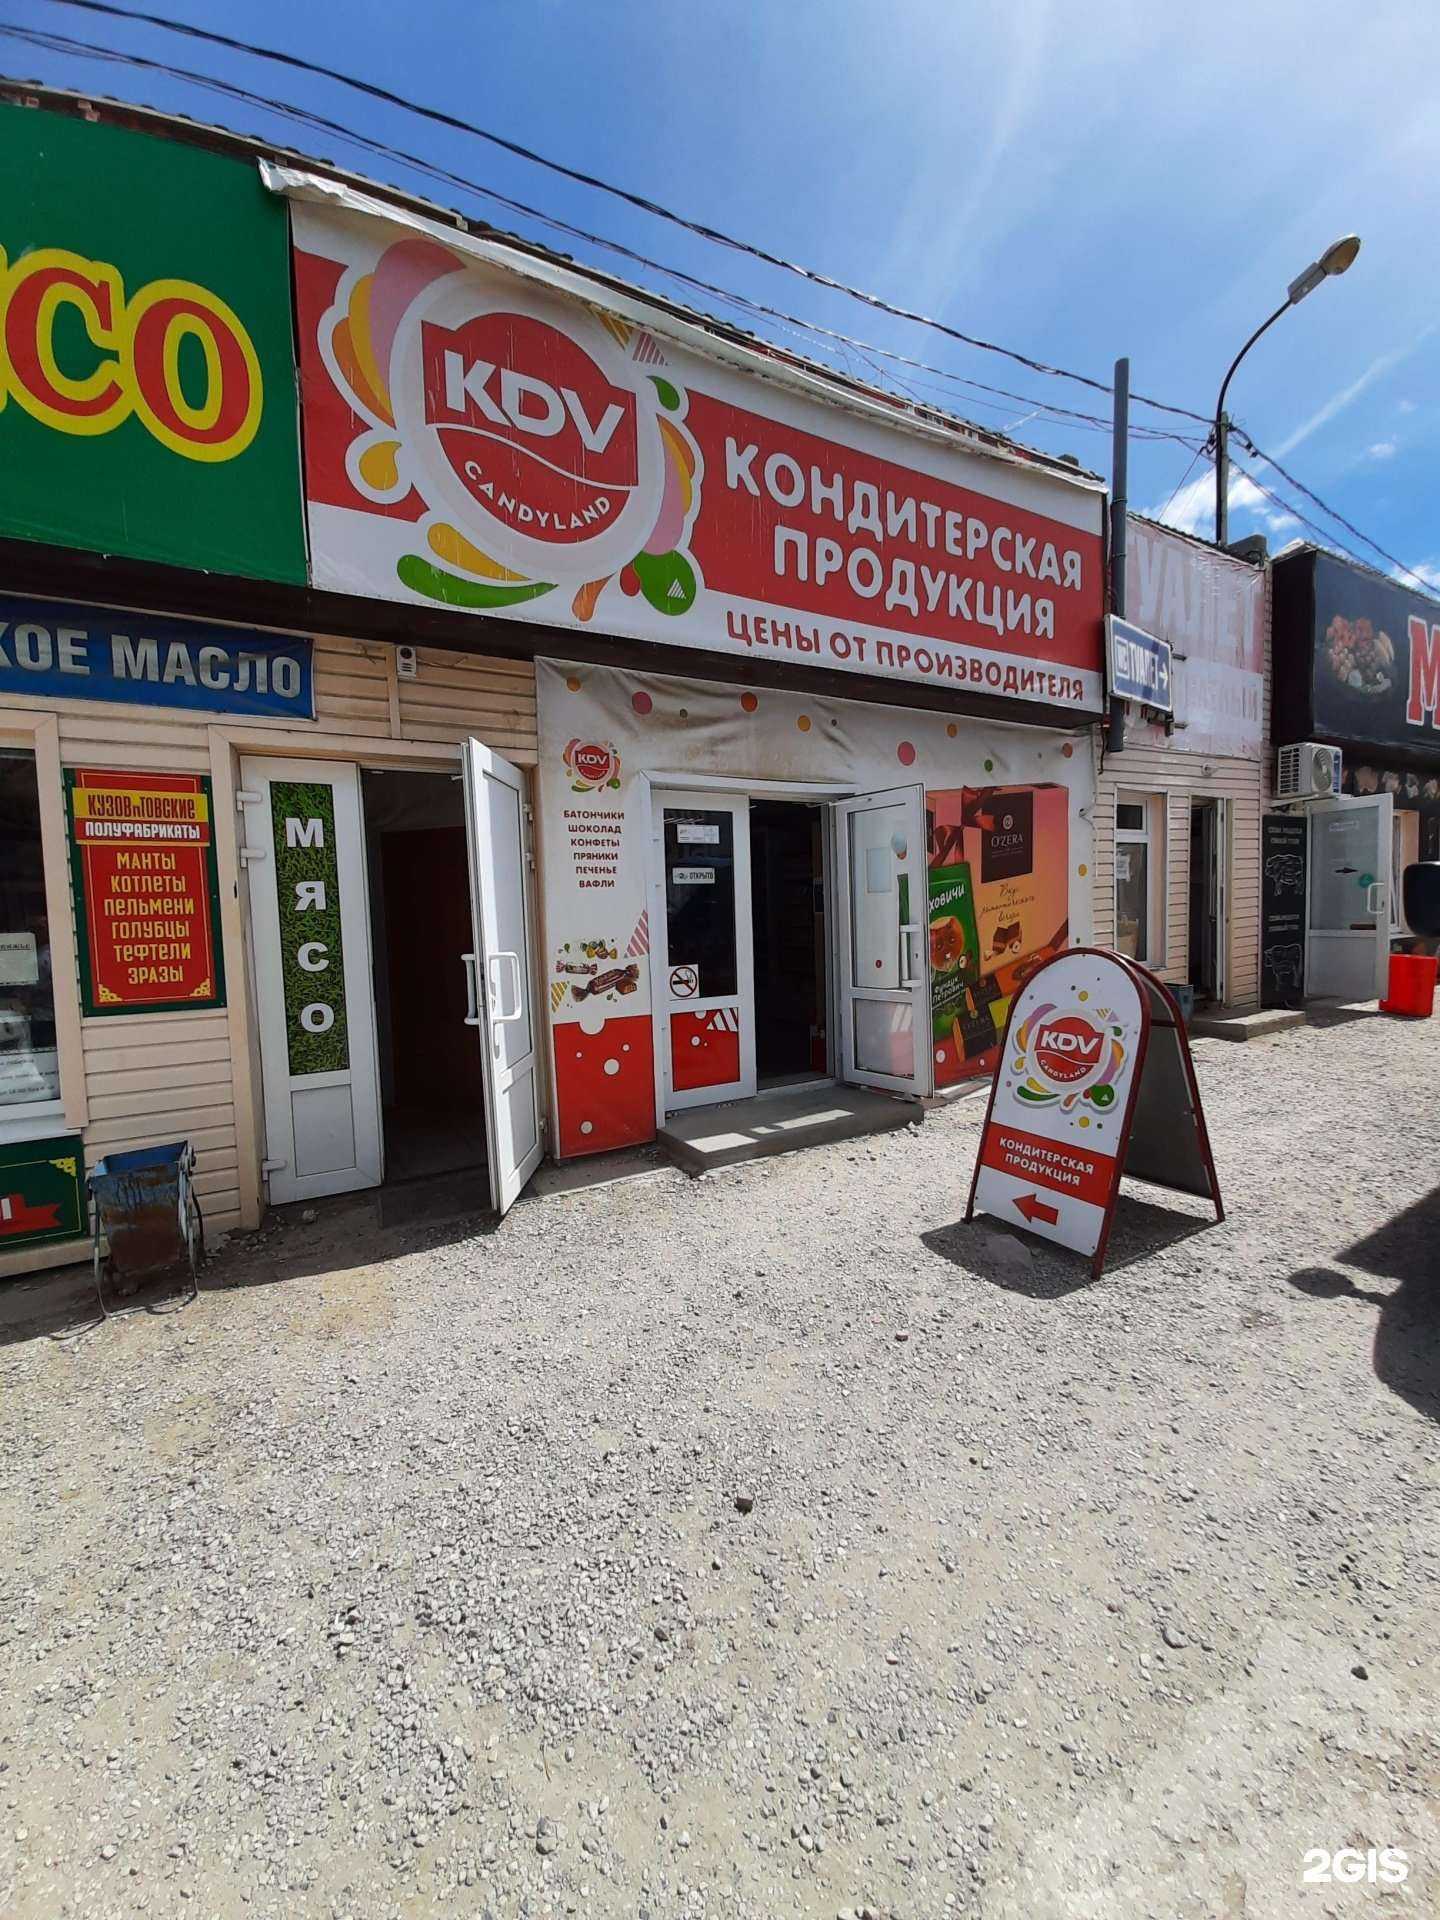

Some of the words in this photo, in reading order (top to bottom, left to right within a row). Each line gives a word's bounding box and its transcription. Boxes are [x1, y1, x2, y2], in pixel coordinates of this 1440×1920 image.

[0, 244, 263, 462] СО
[444, 349, 625, 453] KDV
[463, 459, 611, 530] CANDYLAND
[725, 436, 1082, 592] КОНДИТЕРСКАЯ
[774, 524, 1055, 640] ПРОДУКЦИЯ
[726, 610, 821, 654] ЦЕНЫ
[829, 632, 867, 662] ОТ
[876, 640, 1084, 701] ПРОИЗВОДИТЕЛЯ
[111, 634, 301, 698] МАСЛО
[578, 753, 608, 766] KDV
[563, 810, 625, 820] БАТОНЧИКИ
[85, 822, 200, 839] ПОЛУФАБРИКАТЫ
[568, 824, 622, 834] ШОКОЛАД
[570, 838, 620, 847] КОНФЕТЫ
[116, 852, 176, 870] МАНТЫ
[573, 852, 618, 861] ПРЯНИКИ
[576, 866, 617, 874] ПЕЧЕНЬЕ
[110, 875, 186, 893] КОТЛЕТЫ
[579, 880, 615, 888] ВАФЛИ
[104, 898, 195, 917] ПЕЛЬМЕНИ
[111, 921, 190, 940] ГОЛУБЦЫ
[113, 943, 191, 962] ТЕФТЕЛИ
[128, 966, 184, 984] ЗРАЗЫ
[1041, 1030, 1100, 1055] KDV
[1039, 1059, 1087, 1080] CANDYLAND
[999, 1136, 1094, 1175] КОНДИТЕРСКАЯ
[1005, 1153, 1081, 1186] ПРОДУКЦИЯ
